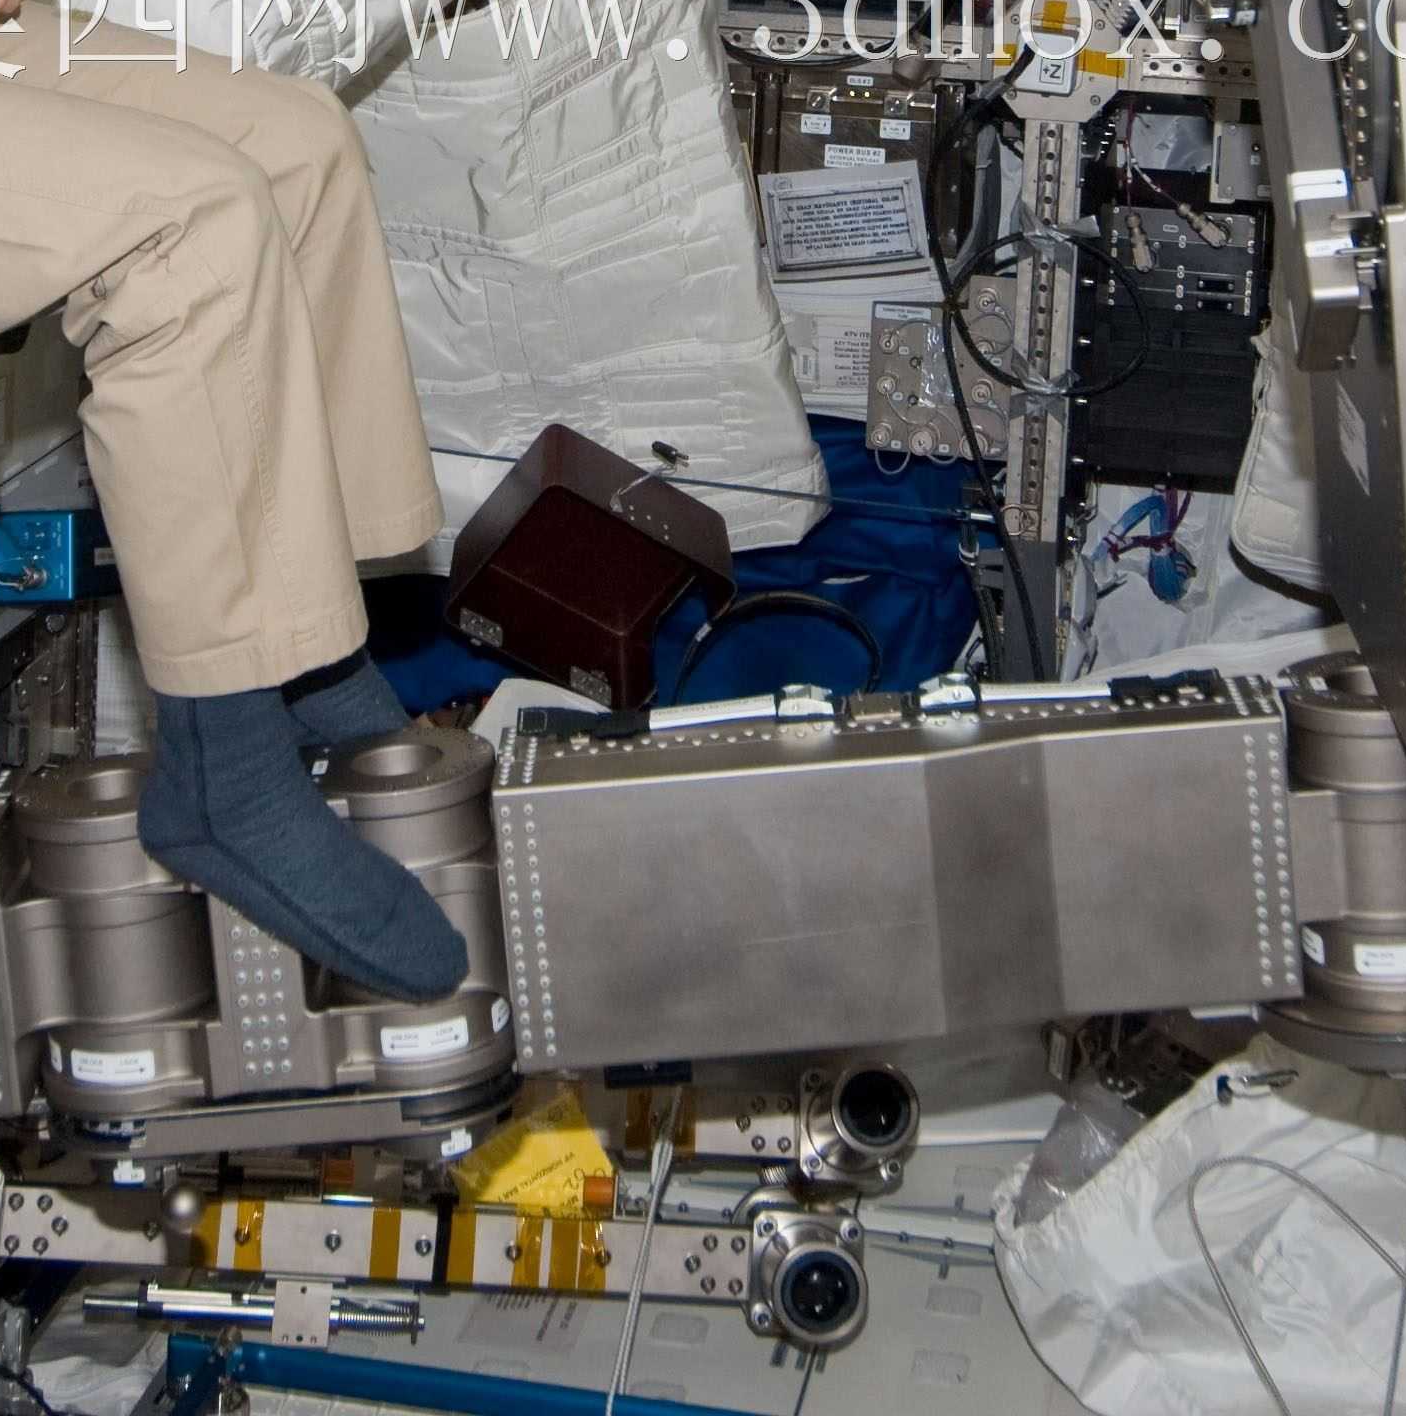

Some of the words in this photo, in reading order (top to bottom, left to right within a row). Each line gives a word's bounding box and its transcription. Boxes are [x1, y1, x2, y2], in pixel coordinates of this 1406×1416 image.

[1042, 63, 1062, 80] +Z
[828, 146, 854, 155] POWER
[856, 147, 871, 156] BUS
